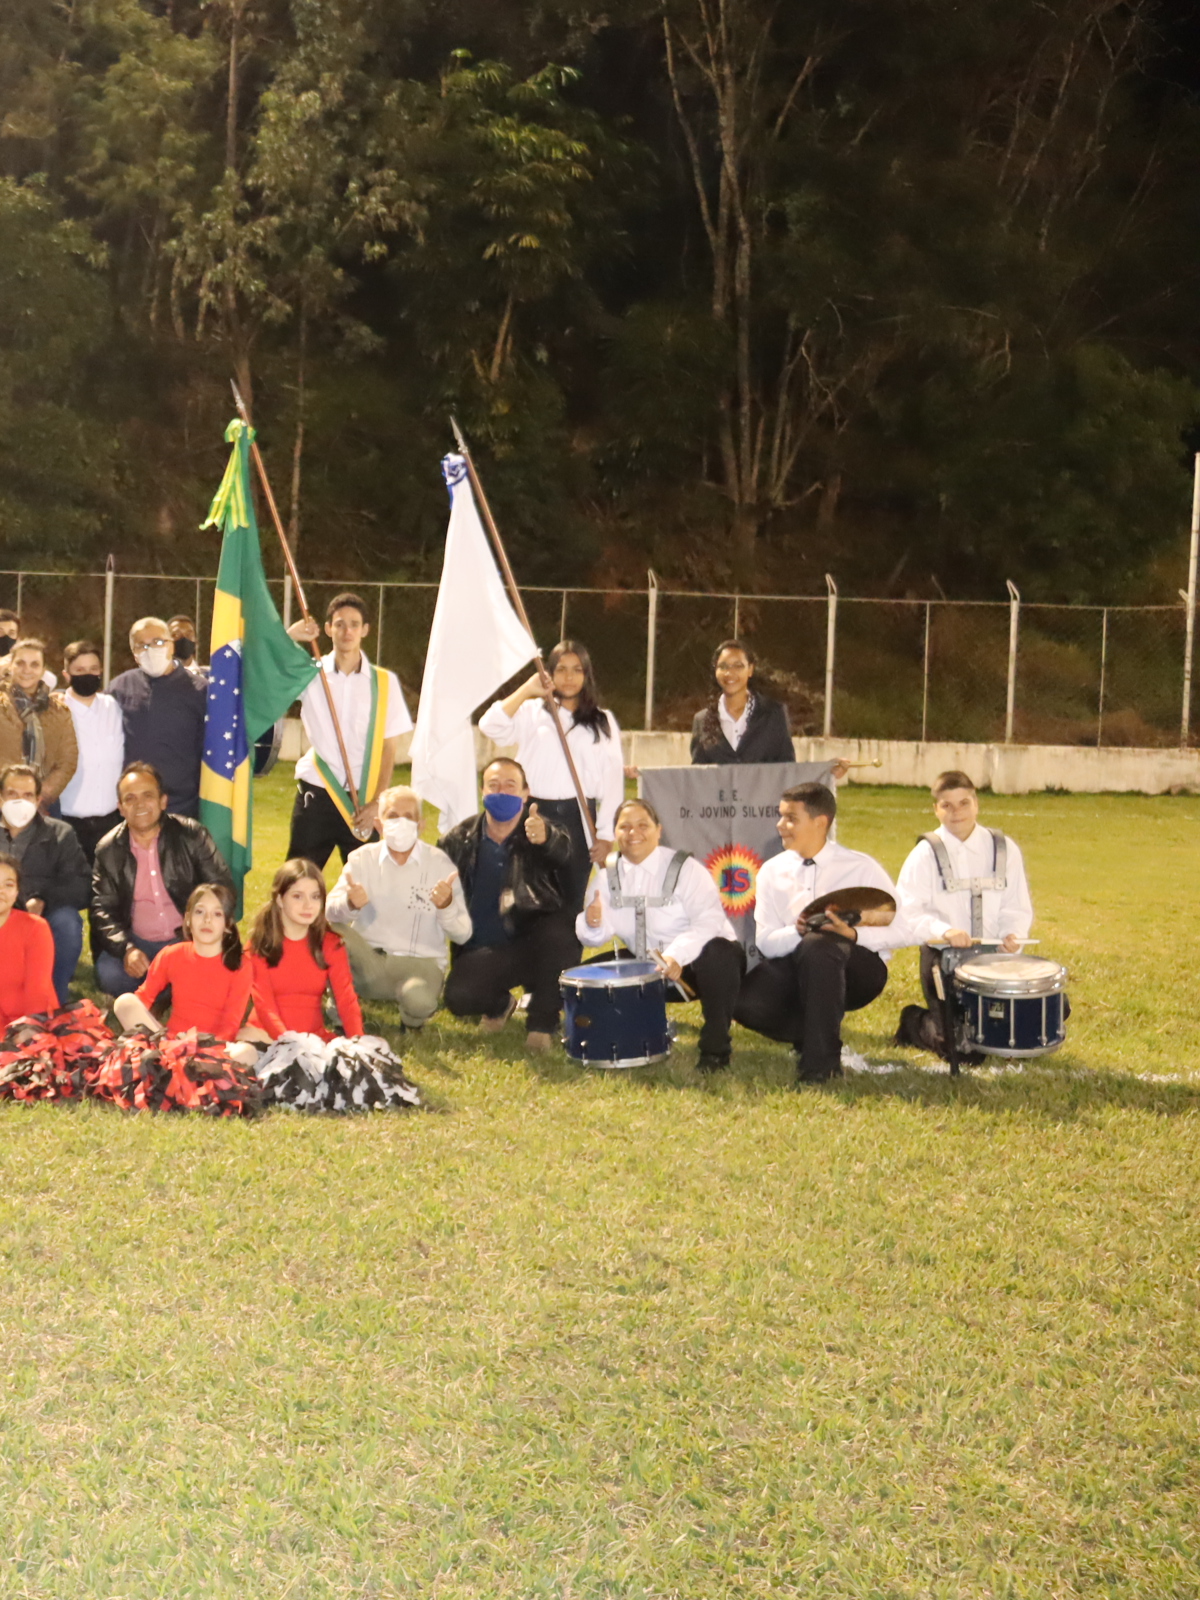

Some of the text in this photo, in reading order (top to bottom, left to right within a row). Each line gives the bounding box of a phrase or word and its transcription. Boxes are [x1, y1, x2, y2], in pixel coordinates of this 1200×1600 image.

[680, 806, 693, 819] Dr.
[700, 805, 736, 818] JOVINO
[720, 868, 750, 893] JS
